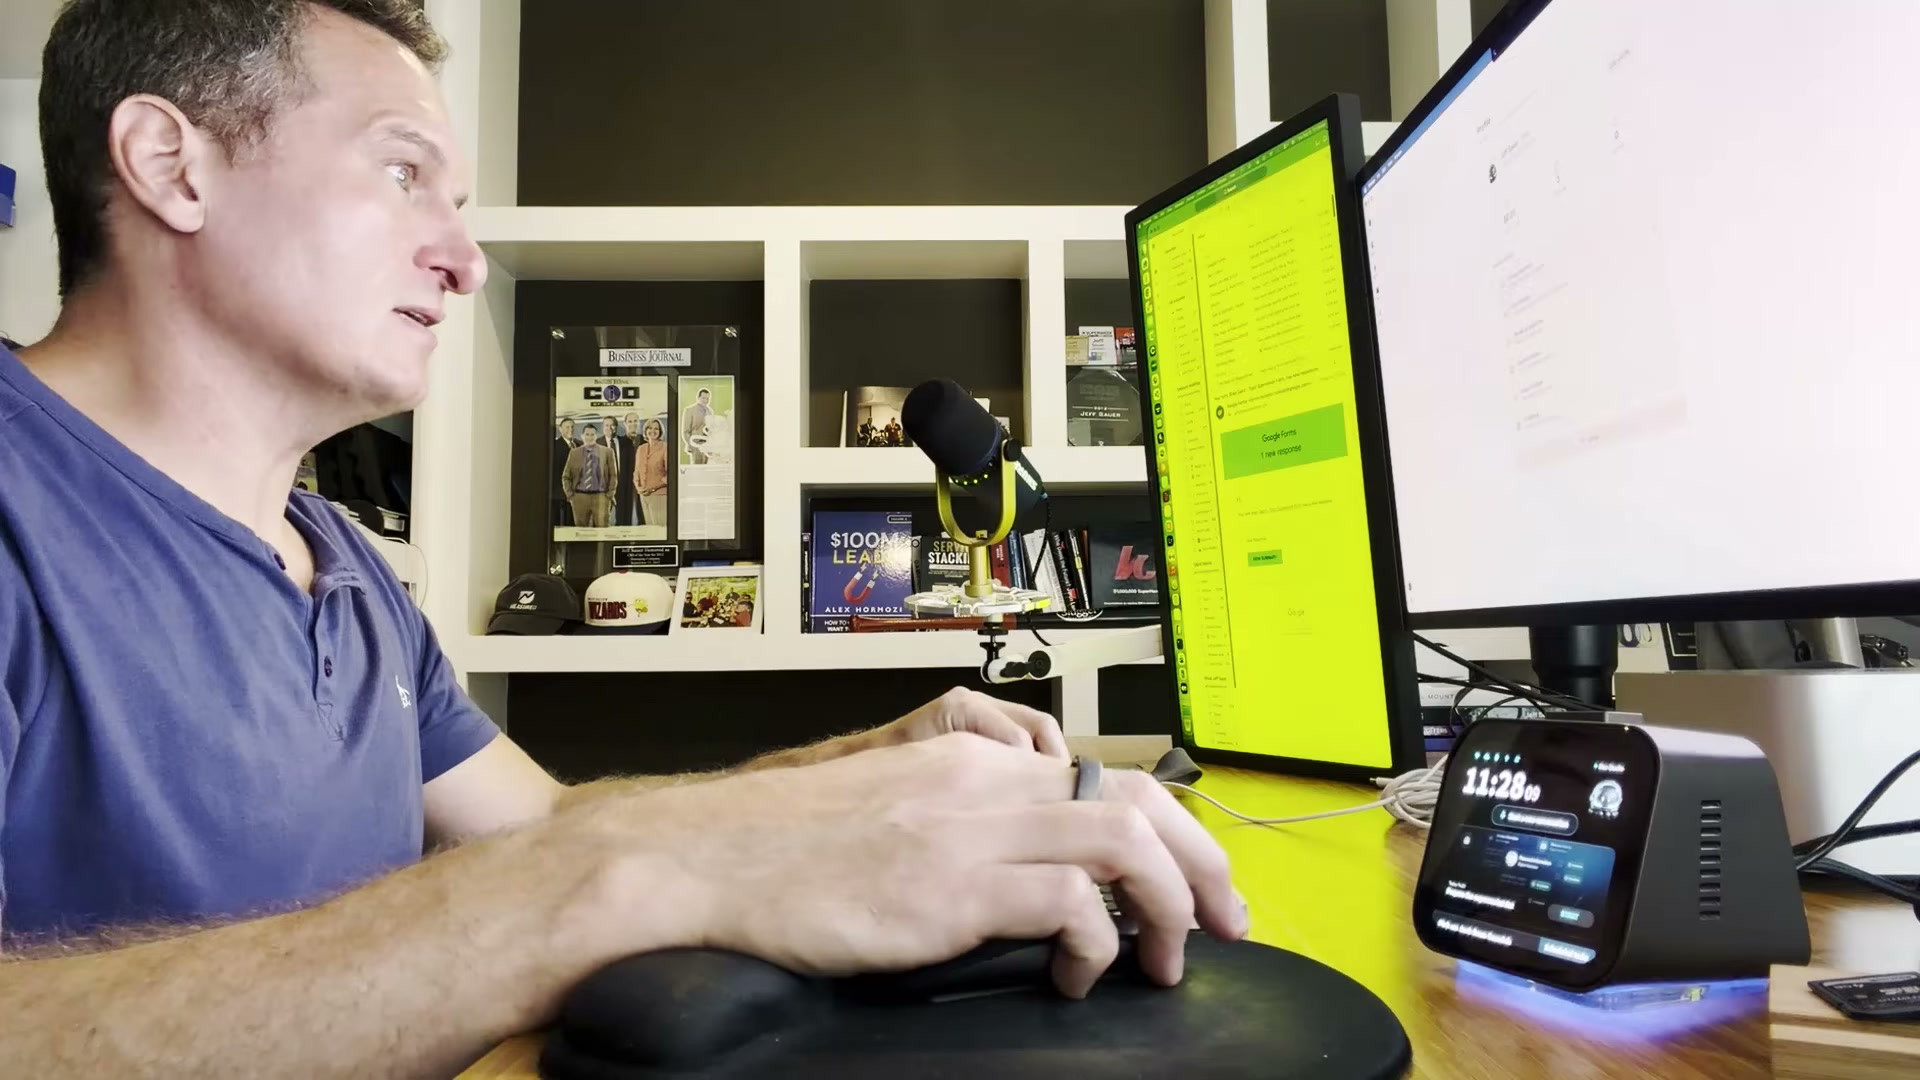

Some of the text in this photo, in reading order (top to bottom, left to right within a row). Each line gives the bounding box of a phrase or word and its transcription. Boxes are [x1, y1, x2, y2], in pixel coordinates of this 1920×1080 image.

[608, 351, 684, 362] BUSINESS JOURNAL
[1262, 429, 1297, 442] Google Forms
[1277, 445, 1302, 456] response
[831, 532, 899, 548] $100M
[833, 550, 890, 564] LEAD
[928, 552, 969, 564] STACKI
[1462, 766, 1541, 802] 11:28 09
